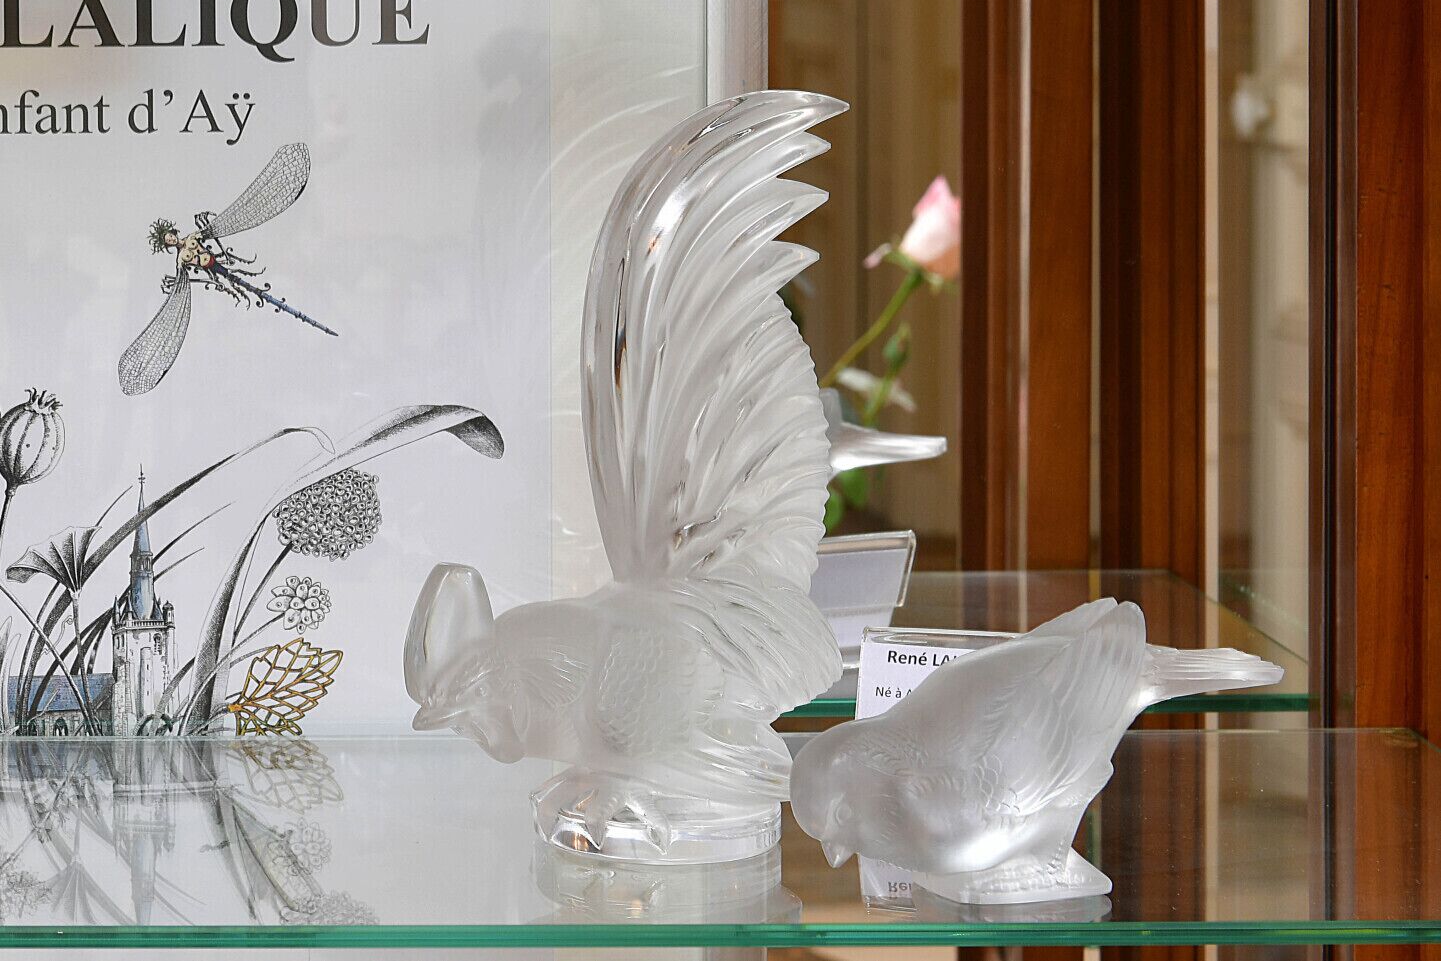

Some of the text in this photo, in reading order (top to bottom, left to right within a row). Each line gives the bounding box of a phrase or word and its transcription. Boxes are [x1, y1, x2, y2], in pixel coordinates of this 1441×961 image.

[887, 650, 928, 666] René
[875, 686, 892, 698] Né
[895, 688, 902, 698] à
